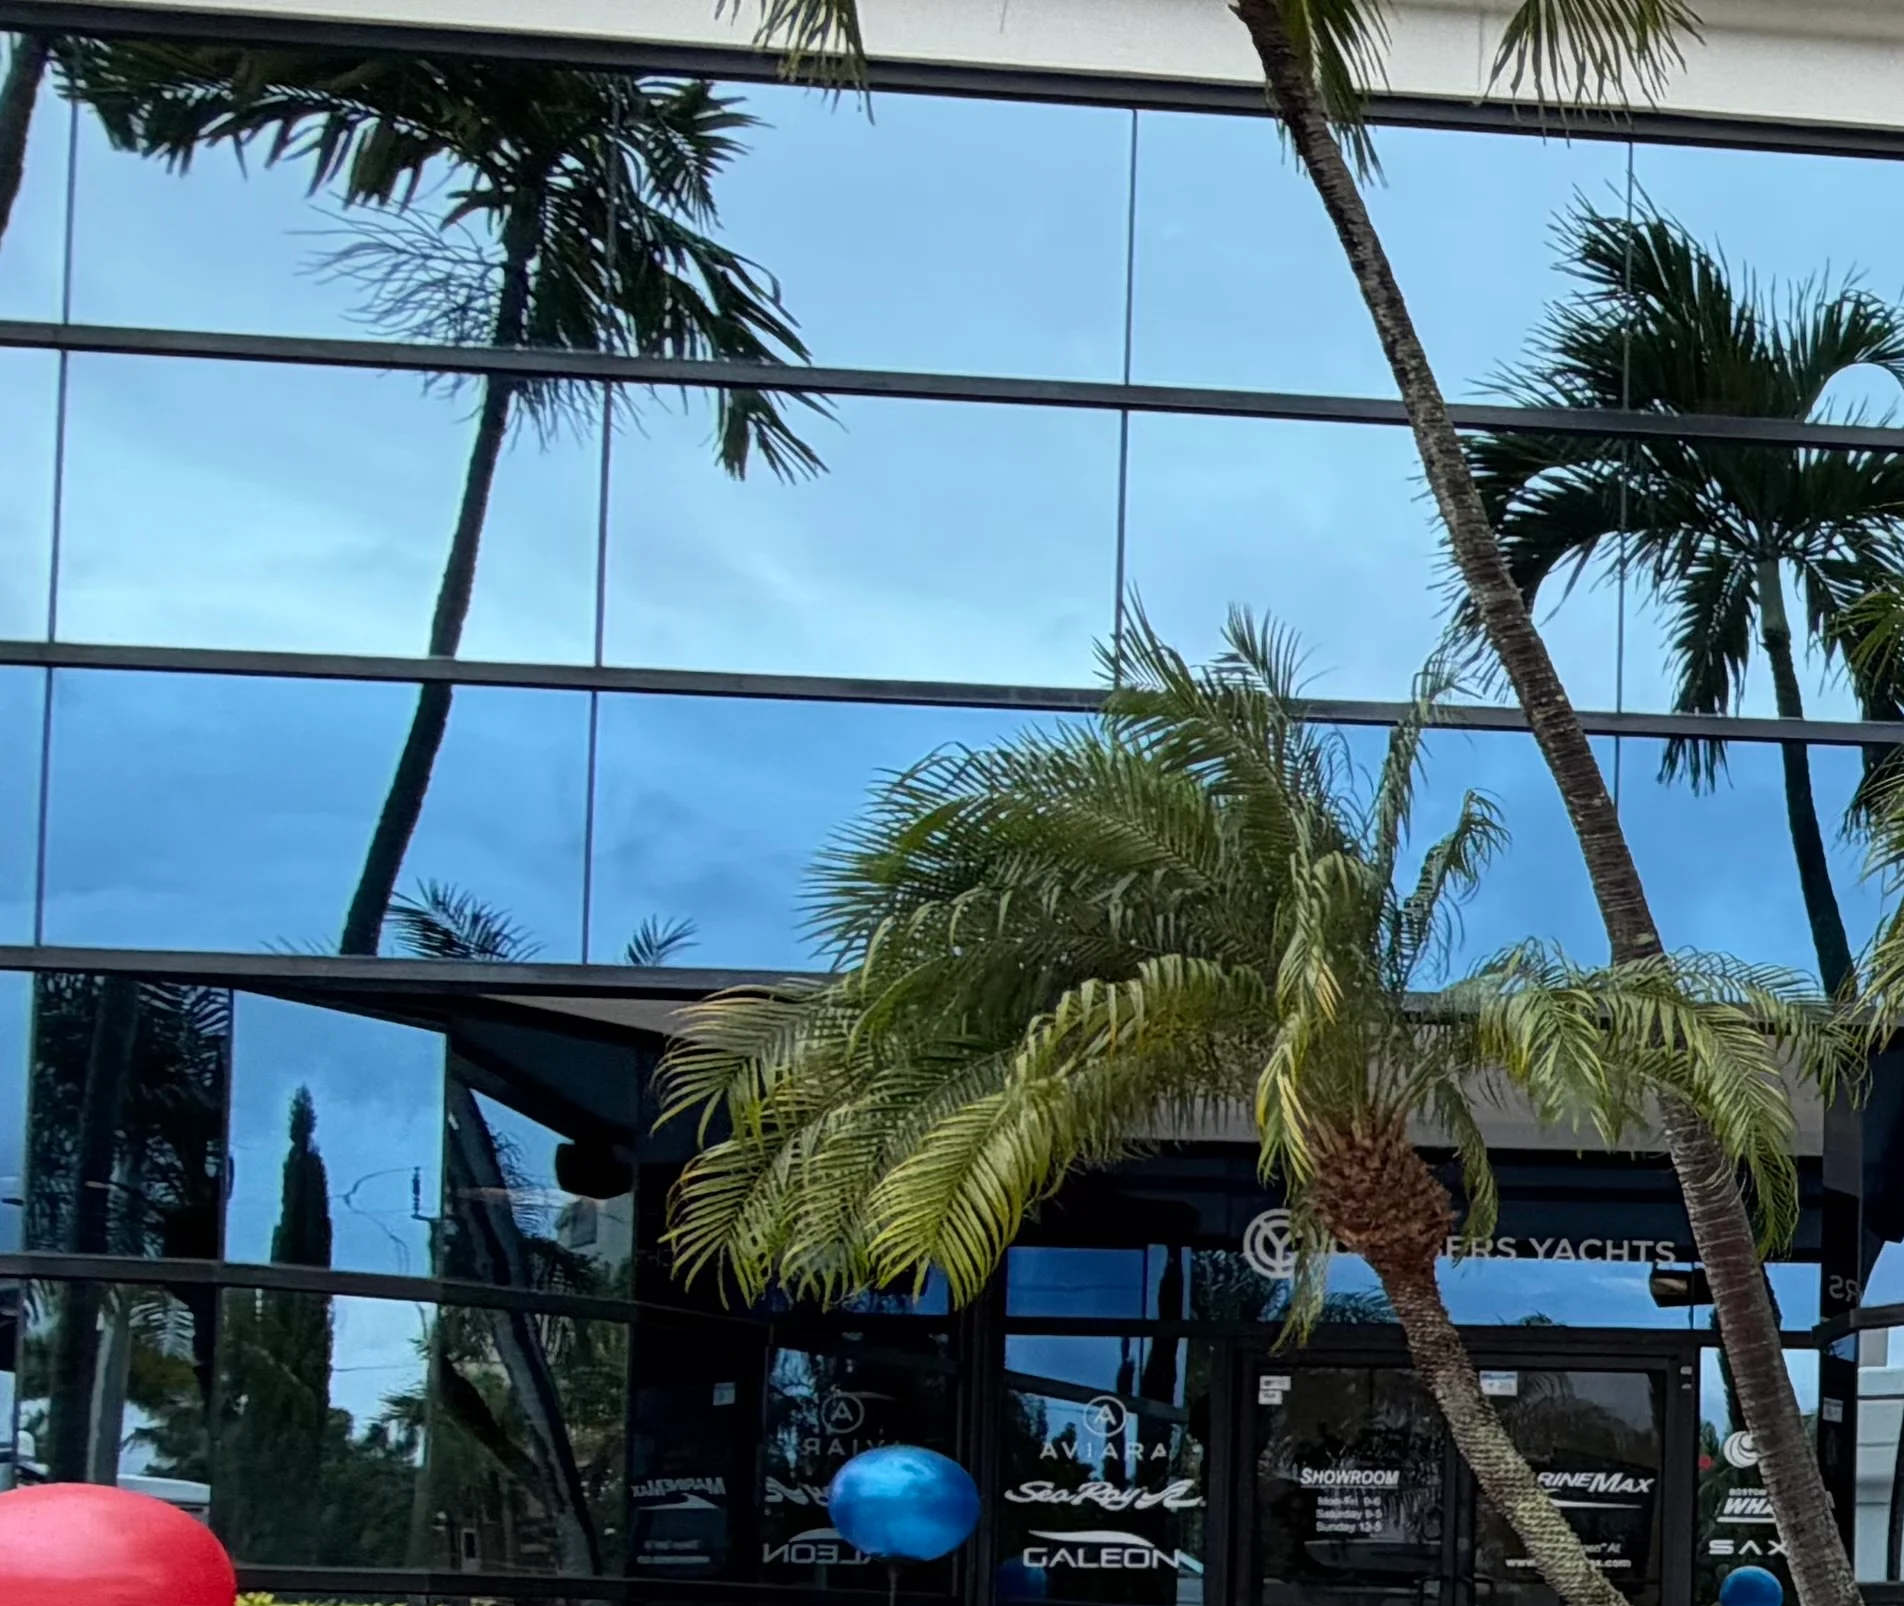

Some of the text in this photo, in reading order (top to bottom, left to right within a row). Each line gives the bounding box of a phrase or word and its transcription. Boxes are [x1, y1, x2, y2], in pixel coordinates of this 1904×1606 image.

[1530, 1236, 1677, 1264] YACHTS
[1039, 1441, 1168, 1460] AVIARA
[1300, 1467, 1400, 1486] SHOWROOM
[1537, 1471, 1655, 1493] RINEMAX
[1022, 1547, 1180, 1569] GALEON
